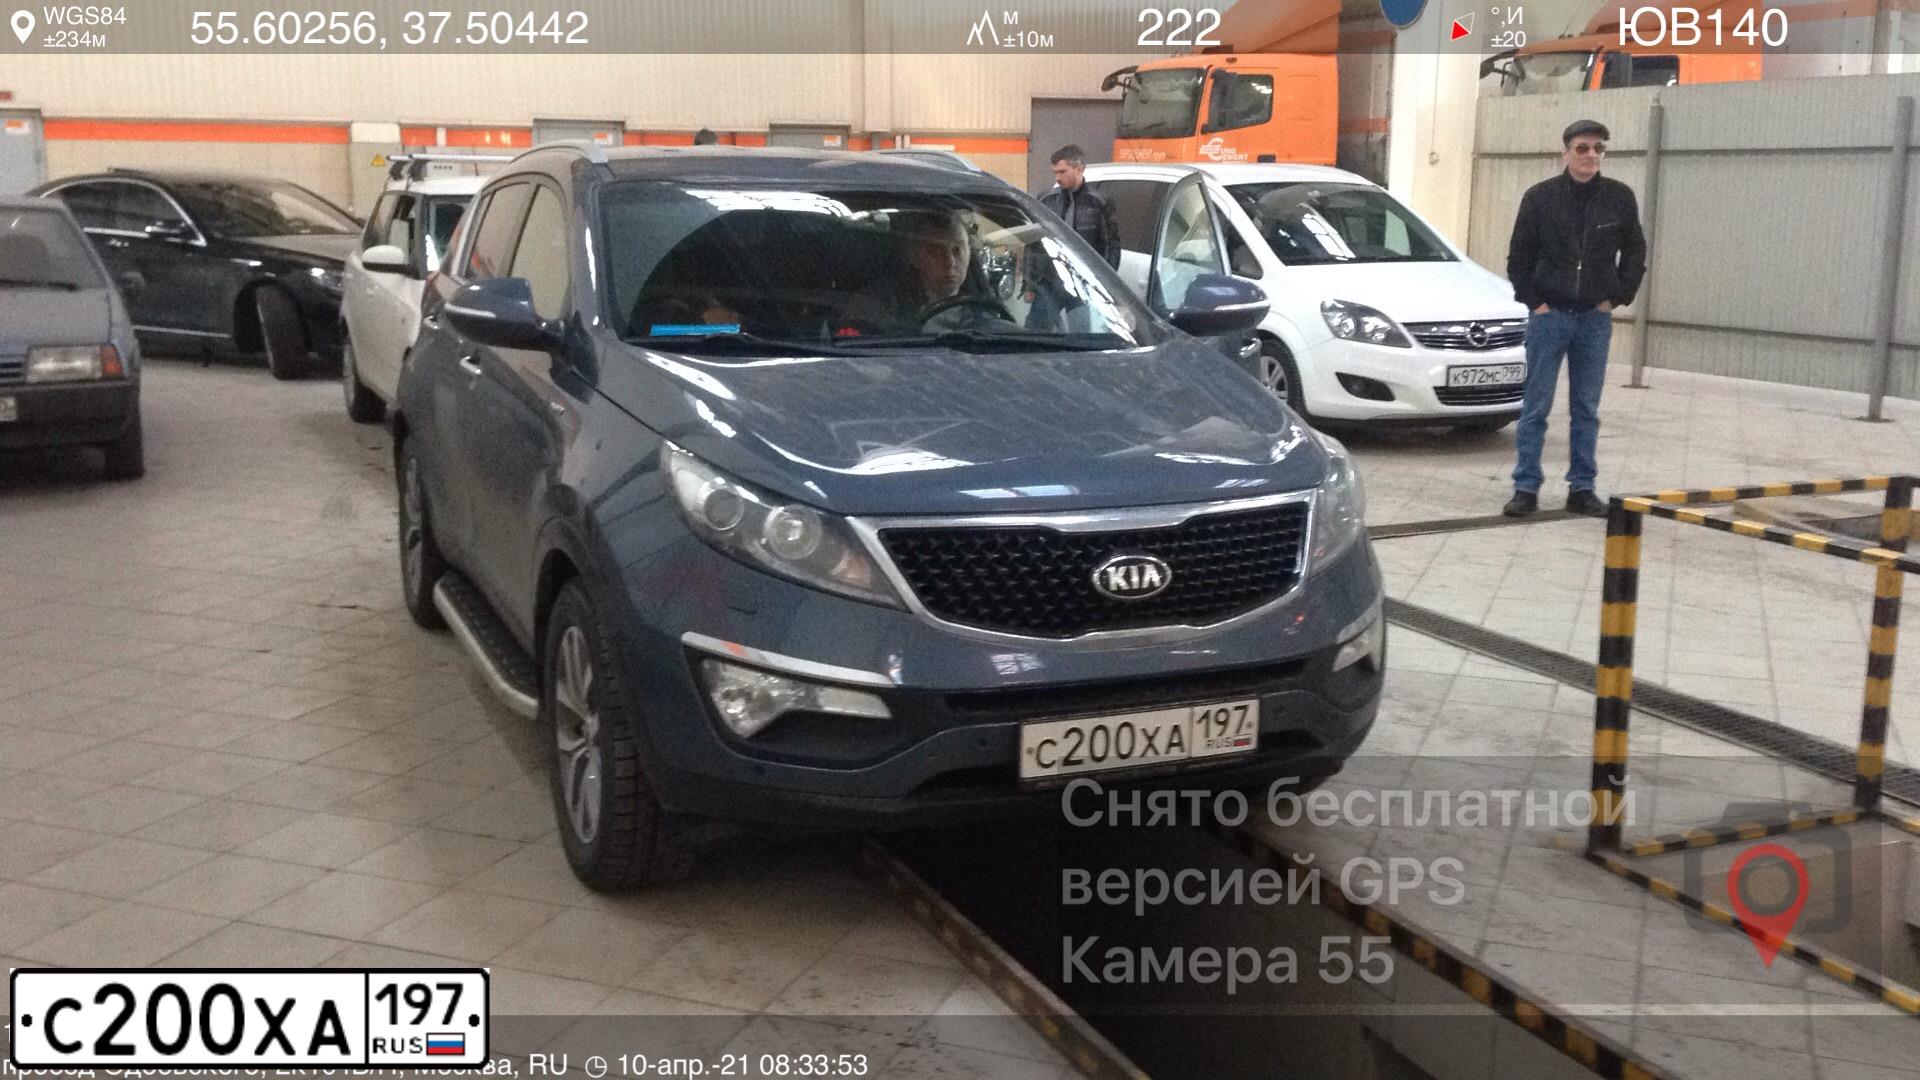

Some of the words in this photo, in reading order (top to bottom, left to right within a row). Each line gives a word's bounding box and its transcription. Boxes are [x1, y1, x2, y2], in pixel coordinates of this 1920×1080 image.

[1106, 564, 1162, 591] KIA
[1196, 704, 1250, 739] 197
[1206, 737, 1232, 750] RUS
